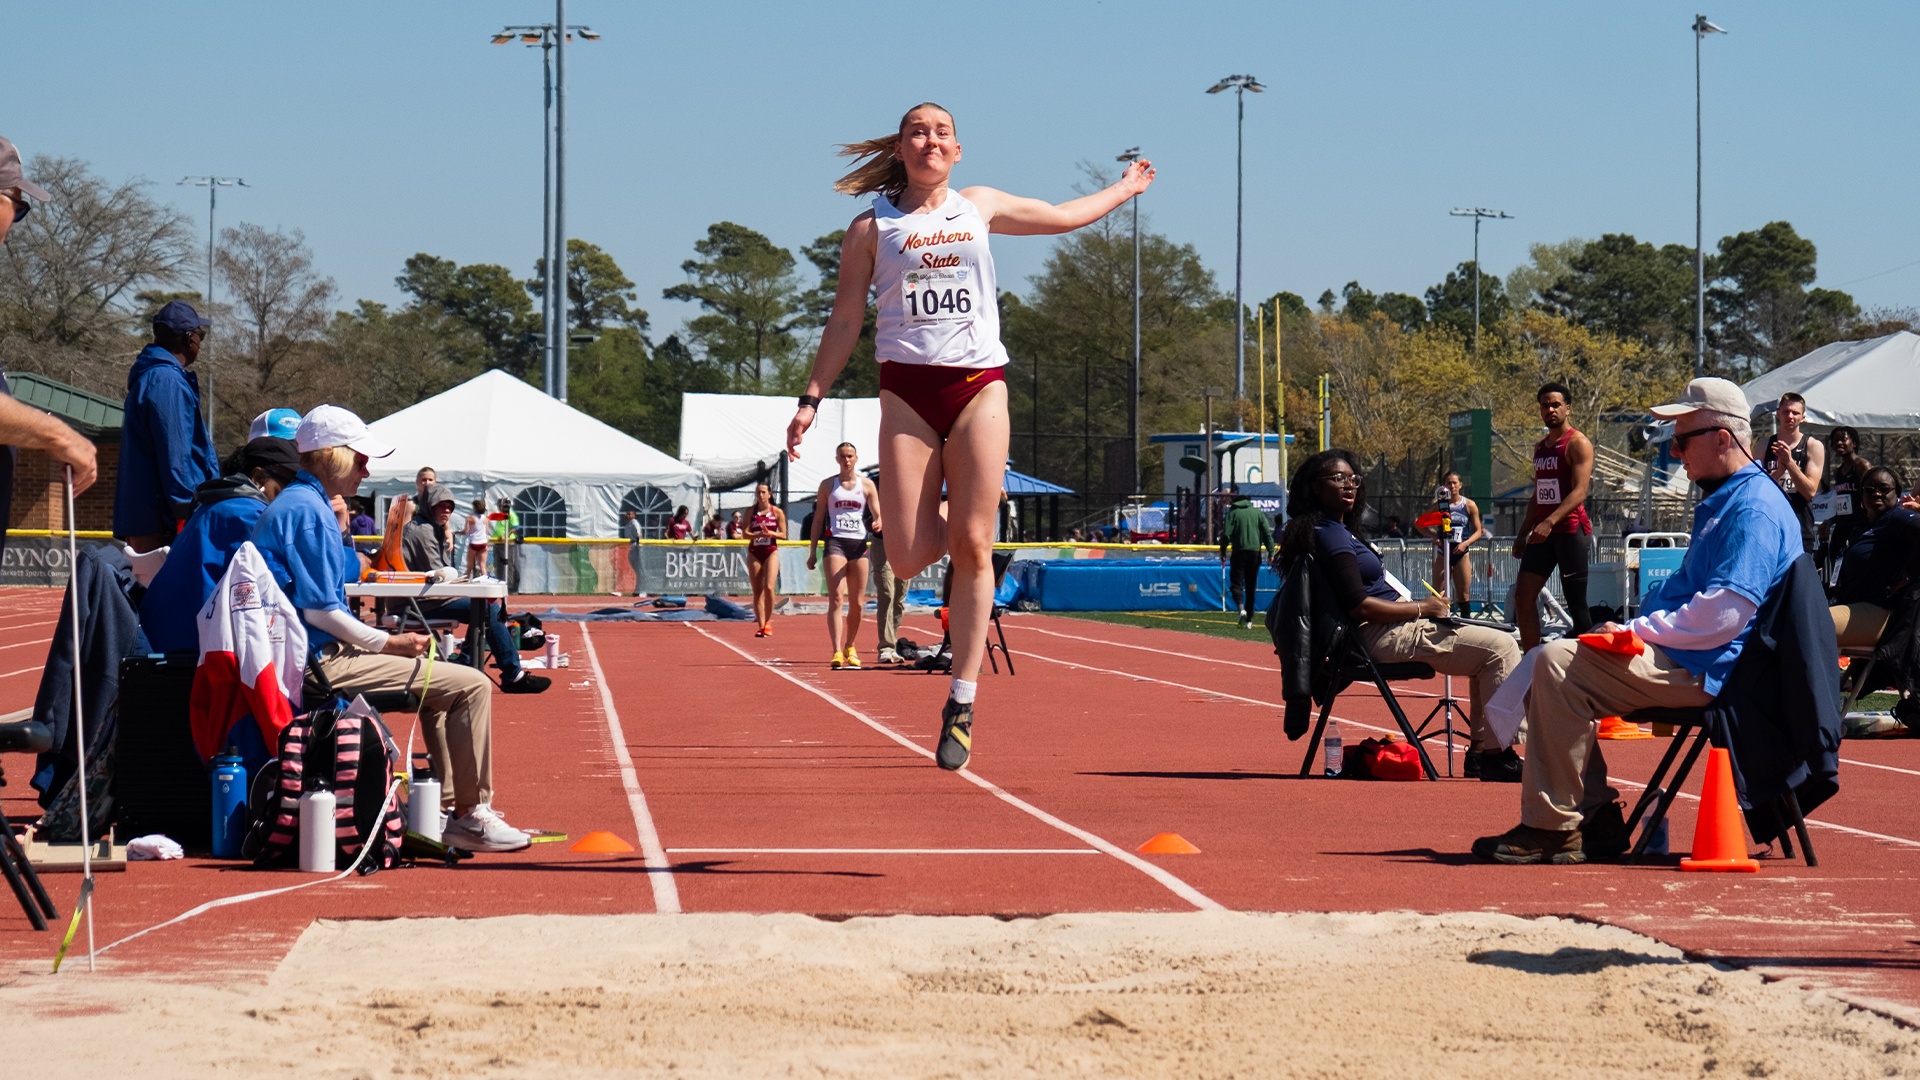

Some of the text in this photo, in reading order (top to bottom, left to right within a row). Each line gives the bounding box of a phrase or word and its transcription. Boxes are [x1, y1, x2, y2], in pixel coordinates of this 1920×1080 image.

[899, 230, 973, 254] Northern
[920, 252, 960, 269] State
[905, 288, 971, 316] 1046
[1534, 456, 1558, 471] HAVEN
[1539, 488, 1555, 500] 690
[665, 552, 750, 578] BRITTAIN
[1648, 568, 1672, 577] KEEP
[1139, 582, 1181, 593] UCS
